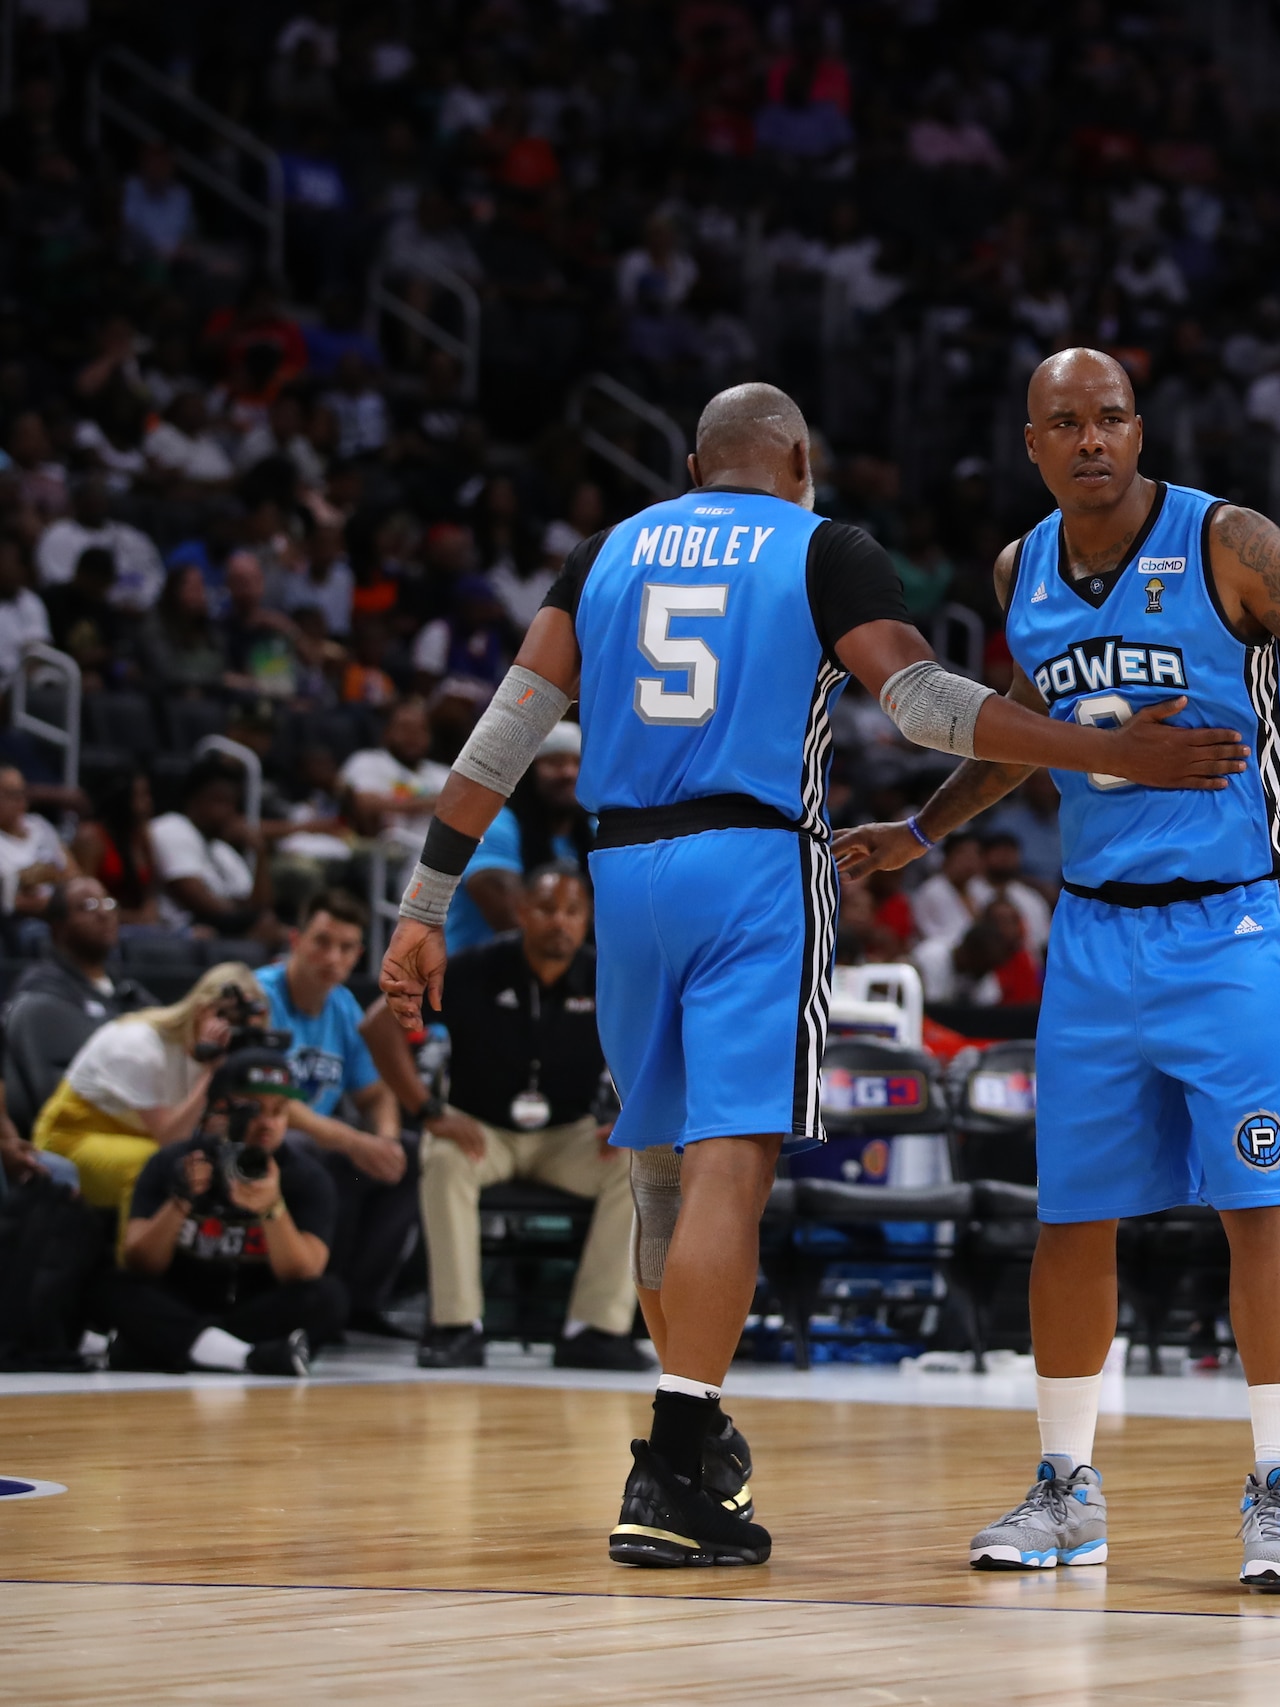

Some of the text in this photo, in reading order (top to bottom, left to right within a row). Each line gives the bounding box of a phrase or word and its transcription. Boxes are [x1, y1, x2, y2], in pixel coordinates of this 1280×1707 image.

[693, 507, 736, 516] BIG3
[631, 524, 776, 568] MOBLEY
[1141, 559, 1184, 572] cbdMD
[632, 582, 730, 727] 5
[1034, 640, 1186, 706] POWER
[1234, 925, 1264, 936] adidas
[1250, 1127, 1276, 1157] P
